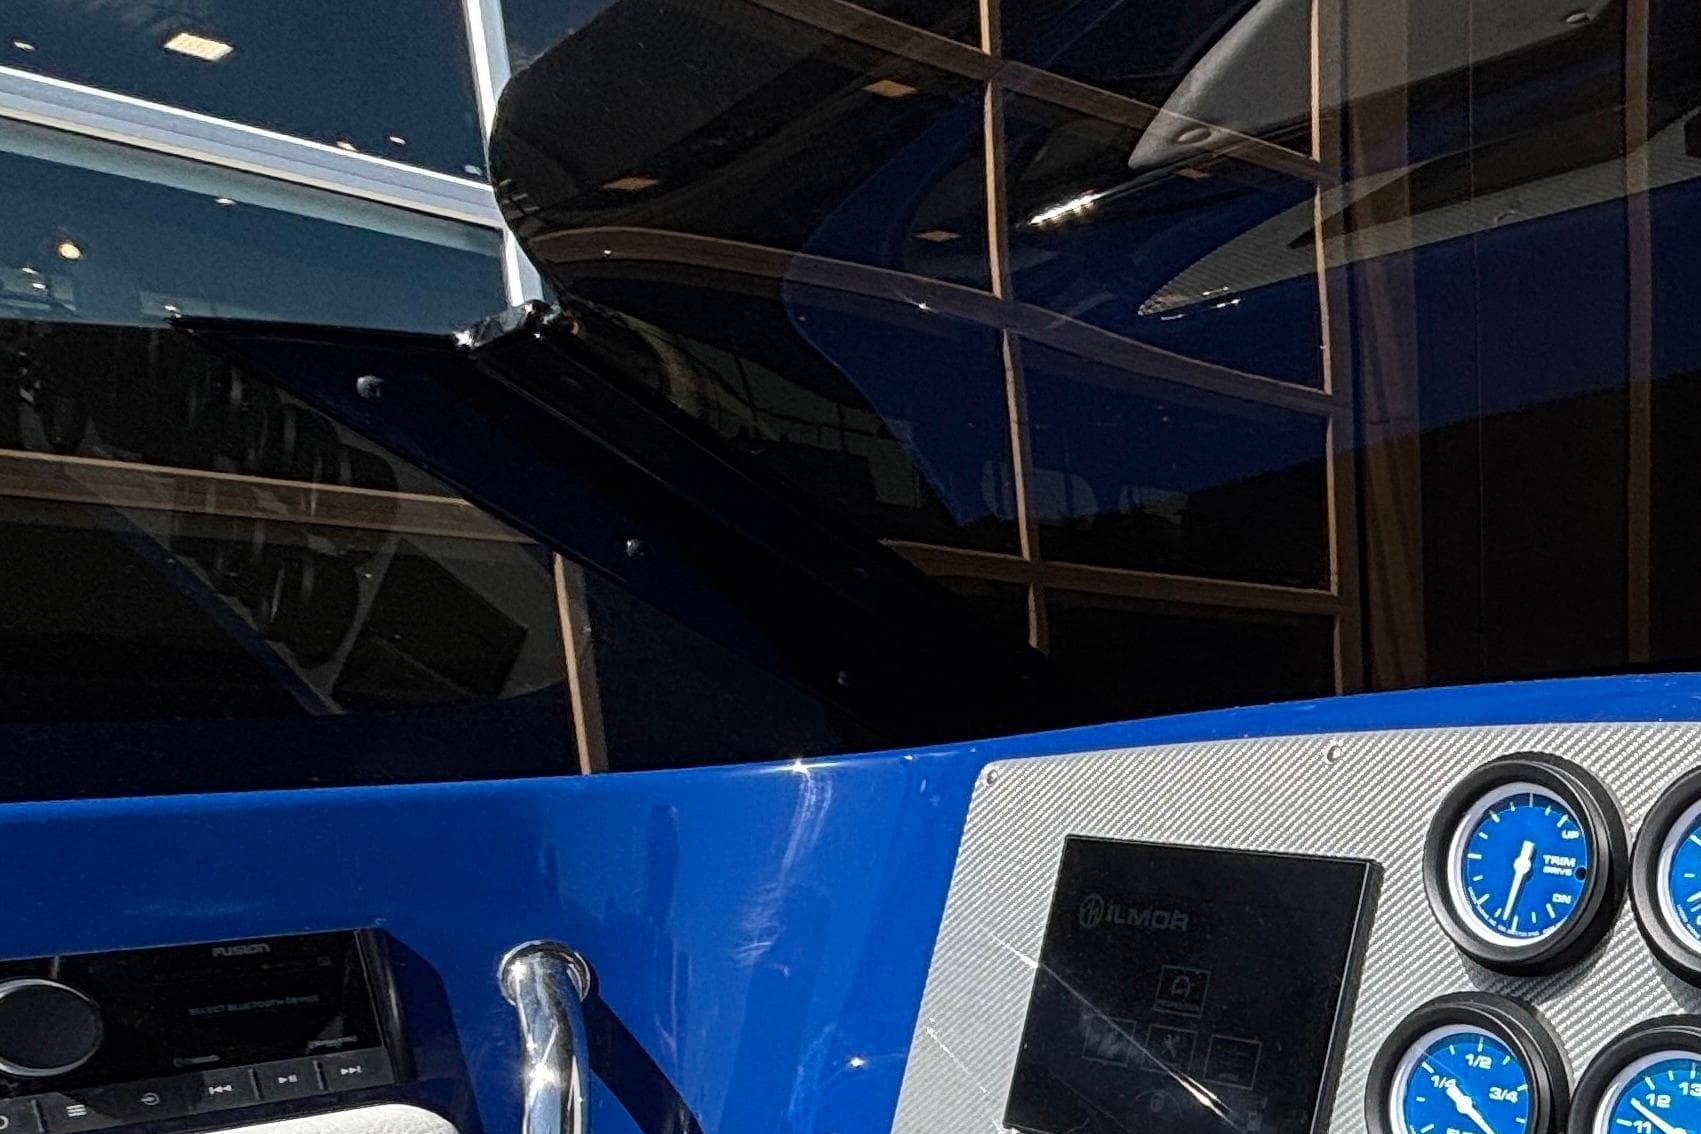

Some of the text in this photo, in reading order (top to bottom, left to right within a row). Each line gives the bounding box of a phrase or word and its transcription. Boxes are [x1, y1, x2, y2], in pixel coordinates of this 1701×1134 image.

[1561, 830, 1579, 839] UP
[1543, 854, 1576, 867] TRIM
[1106, 904, 1190, 931] ILMOR
[1465, 1053, 1493, 1069] 1/2
[1431, 1075, 1457, 1090] 1/4
[1489, 1086, 1519, 1103] 3/4
[1646, 1093, 1671, 1108] 12
[1633, 1119, 1653, 1134] 11
